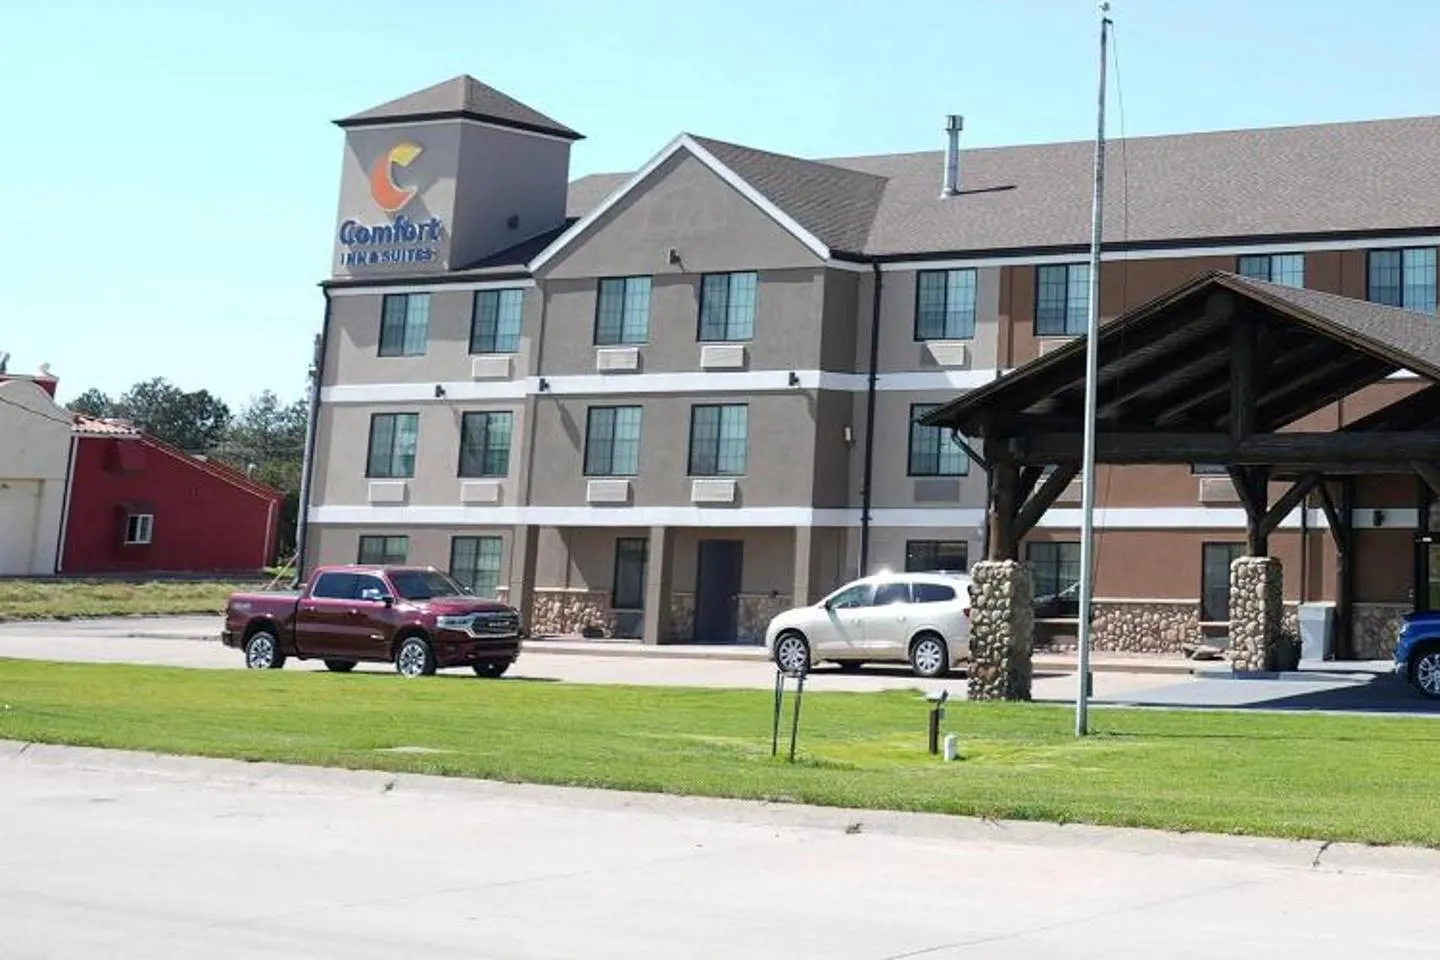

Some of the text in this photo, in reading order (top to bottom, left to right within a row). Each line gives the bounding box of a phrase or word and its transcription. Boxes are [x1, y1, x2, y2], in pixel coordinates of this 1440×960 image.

[340, 215, 440, 245] Comfort
[341, 251, 368, 266] INN
[381, 247, 433, 264] SUITES
